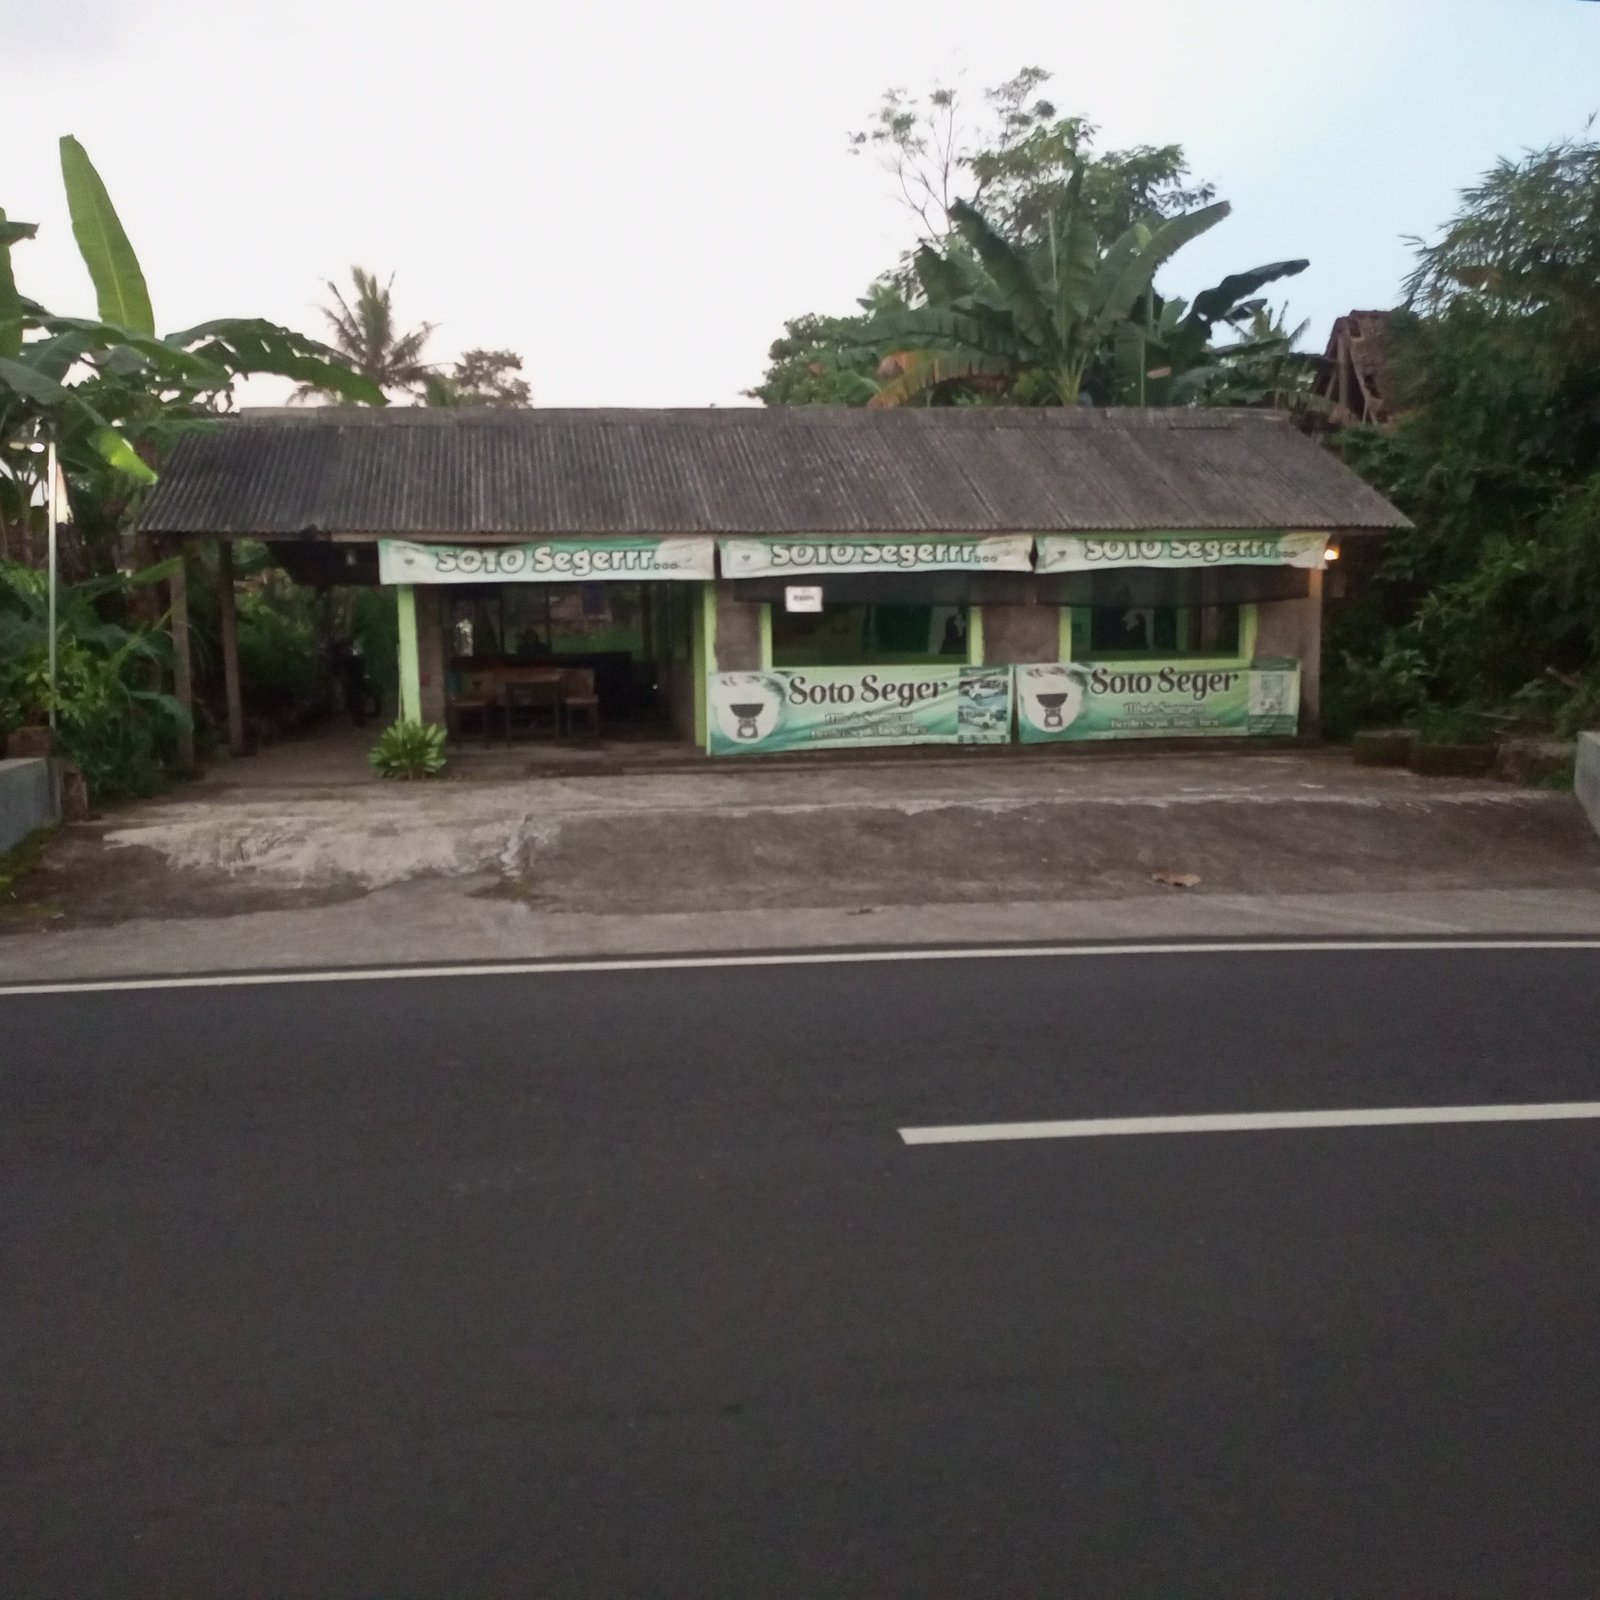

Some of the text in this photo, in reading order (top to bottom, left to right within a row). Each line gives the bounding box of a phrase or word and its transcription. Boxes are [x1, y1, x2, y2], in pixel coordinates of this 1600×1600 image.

[789, 674, 949, 708] Soto Seger
[1090, 667, 1239, 701] Soto Seger
